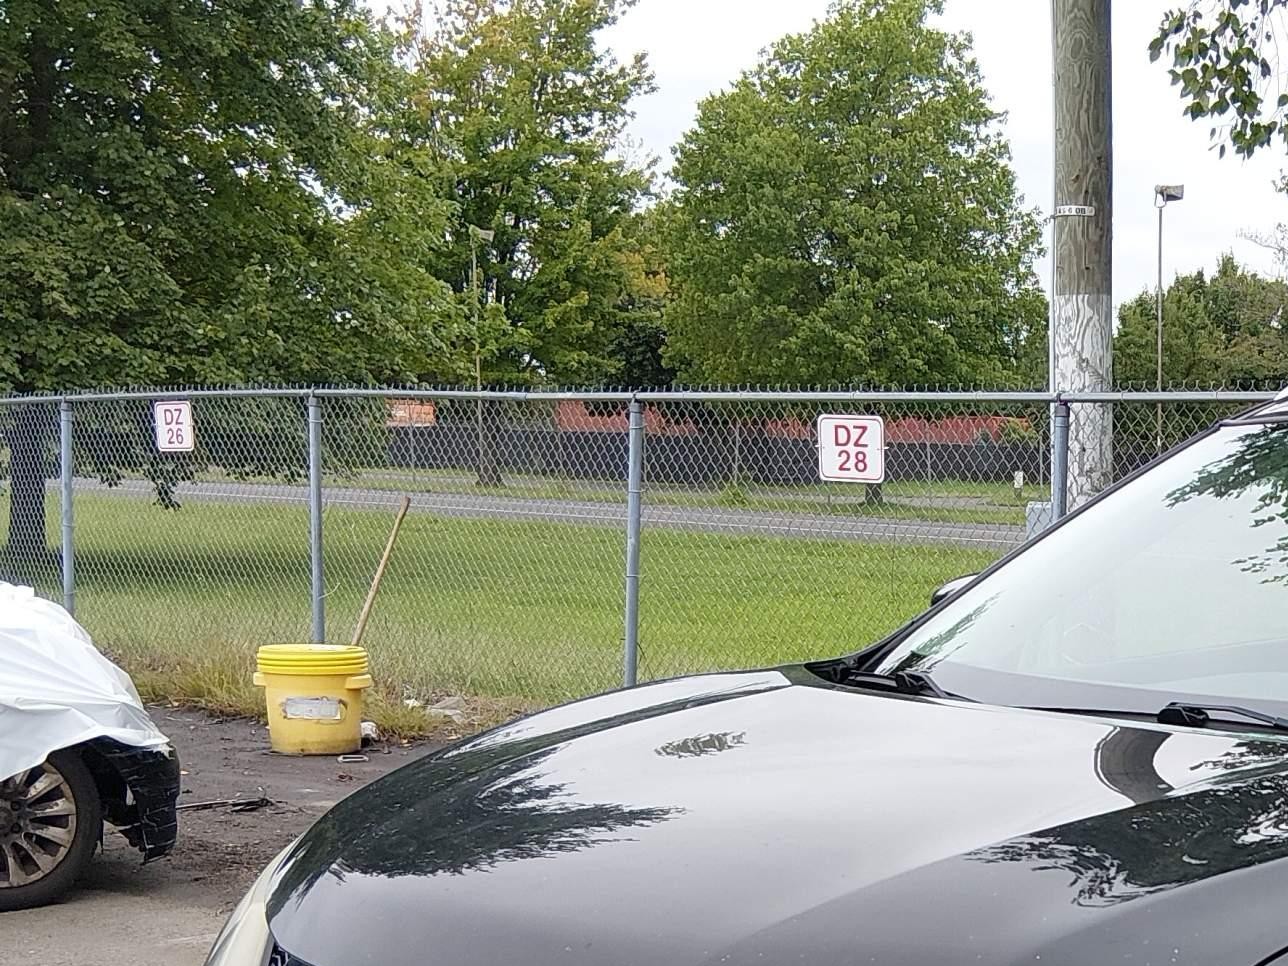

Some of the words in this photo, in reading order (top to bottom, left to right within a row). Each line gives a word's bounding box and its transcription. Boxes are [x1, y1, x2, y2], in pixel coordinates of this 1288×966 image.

[163, 408, 184, 425] DZ
[167, 428, 184, 445] 26
[834, 424, 868, 447] DZ
[838, 449, 868, 473] 28
